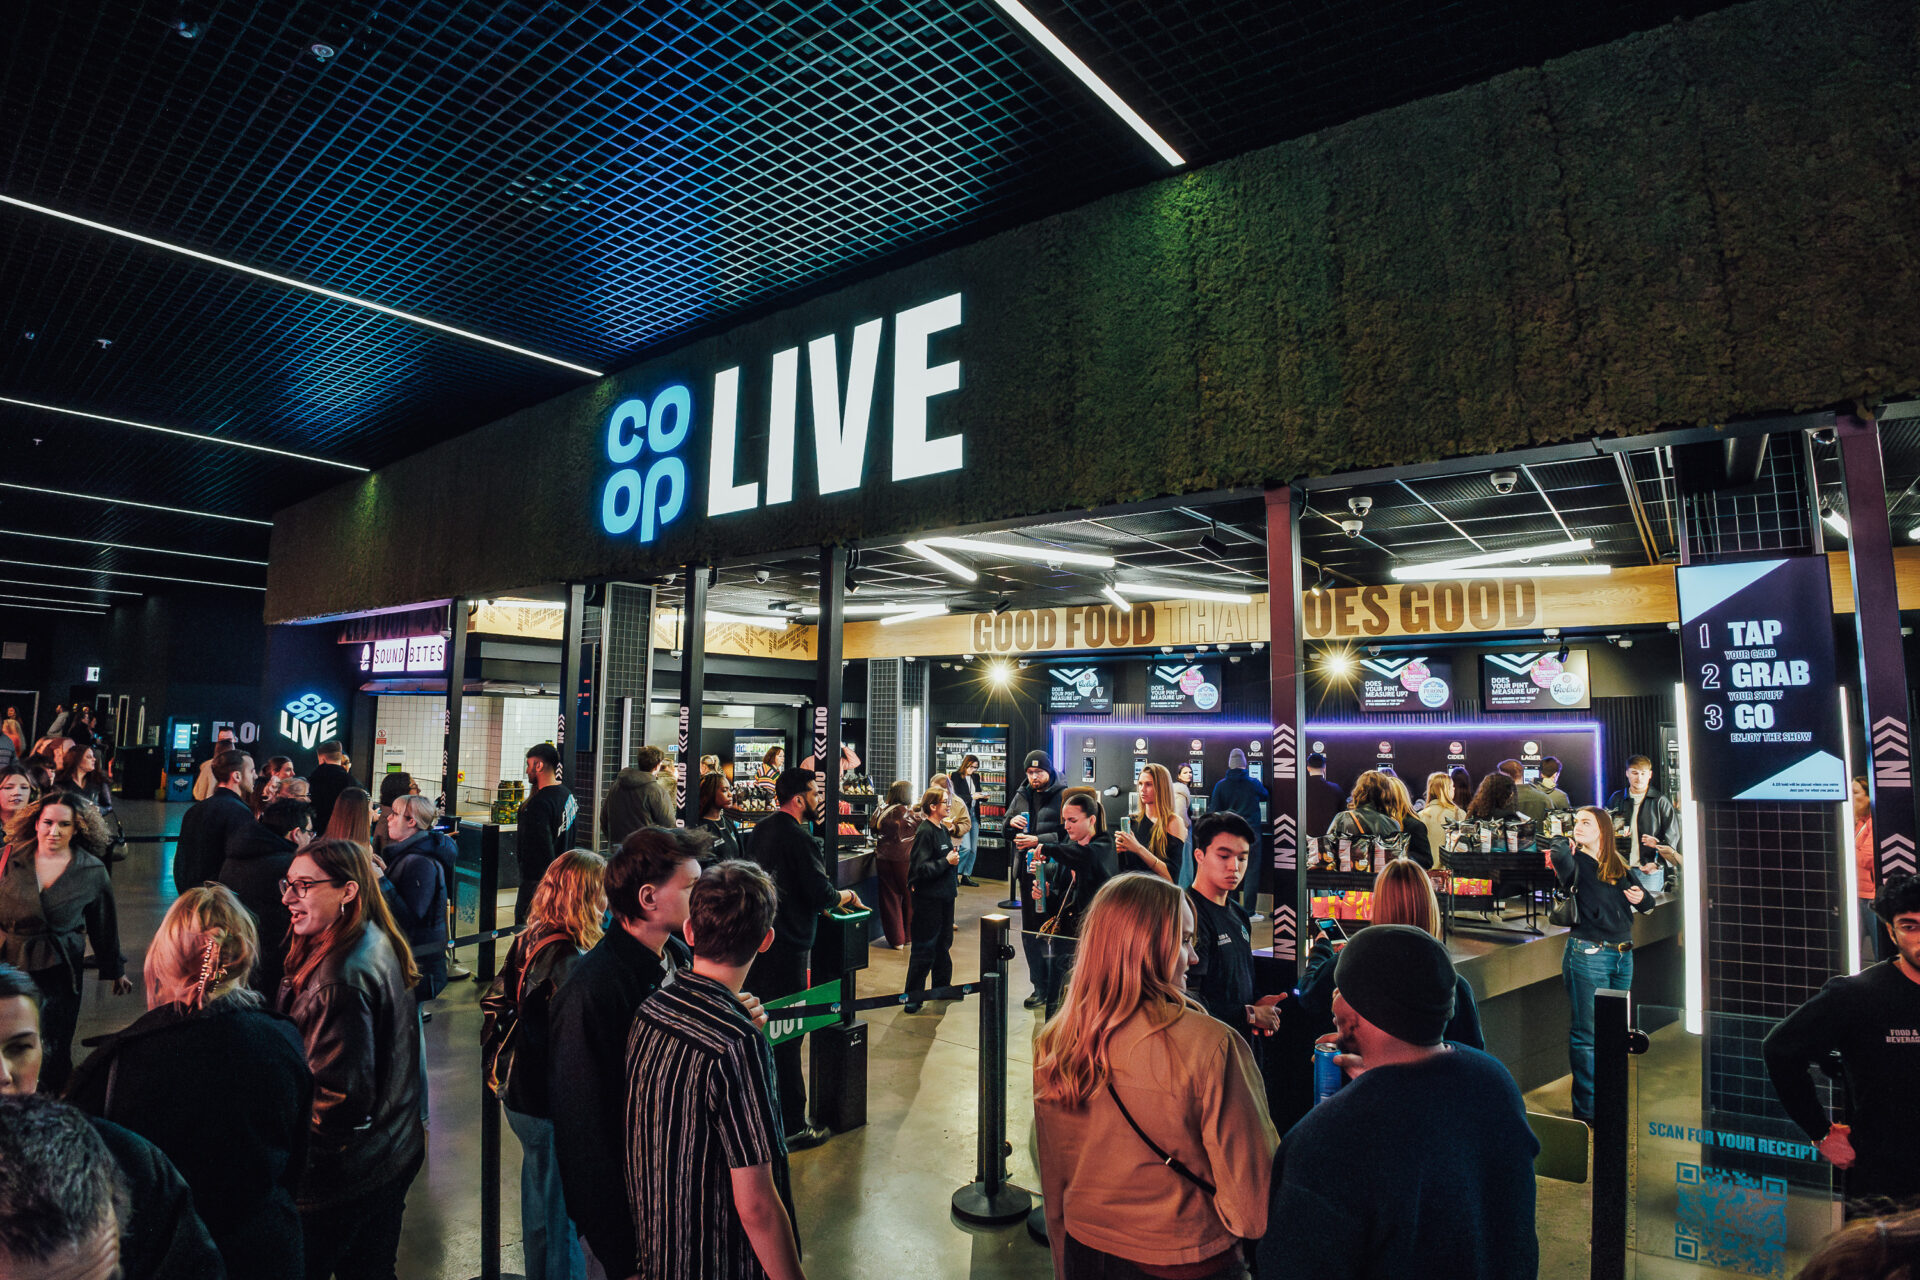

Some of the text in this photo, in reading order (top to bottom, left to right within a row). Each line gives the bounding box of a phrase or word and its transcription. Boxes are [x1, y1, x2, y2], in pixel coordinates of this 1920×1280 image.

[707, 292, 963, 517] LIVE
[974, 577, 1536, 652] GOOD FOOD THAT OES GOOD
[1699, 620, 1782, 649] 1 TAP
[375, 645, 443, 664] SOUND BITES
[1724, 649, 1776, 660] YOUR CARD
[1701, 660, 1811, 689] 2 GRAB
[1727, 690, 1784, 701] YOUR STUFF
[280, 709, 338, 750] LIVE
[680, 707, 689, 732] OUT
[815, 707, 828, 736] OUT
[1704, 703, 1775, 731] 3 GO
[557, 732, 564, 744] IN
[1731, 731, 1812, 743] ENJOY THE SHOW
[677, 763, 687, 792] OUT
[1274, 757, 1296, 779] IN
[1875, 760, 1911, 787] IN
[1274, 848, 1296, 870] IN
[1274, 938, 1296, 961] IN
[769, 1000, 807, 1040] OUT
[1648, 1121, 1819, 1162] SCAN FOR YOUR RECEIPT
